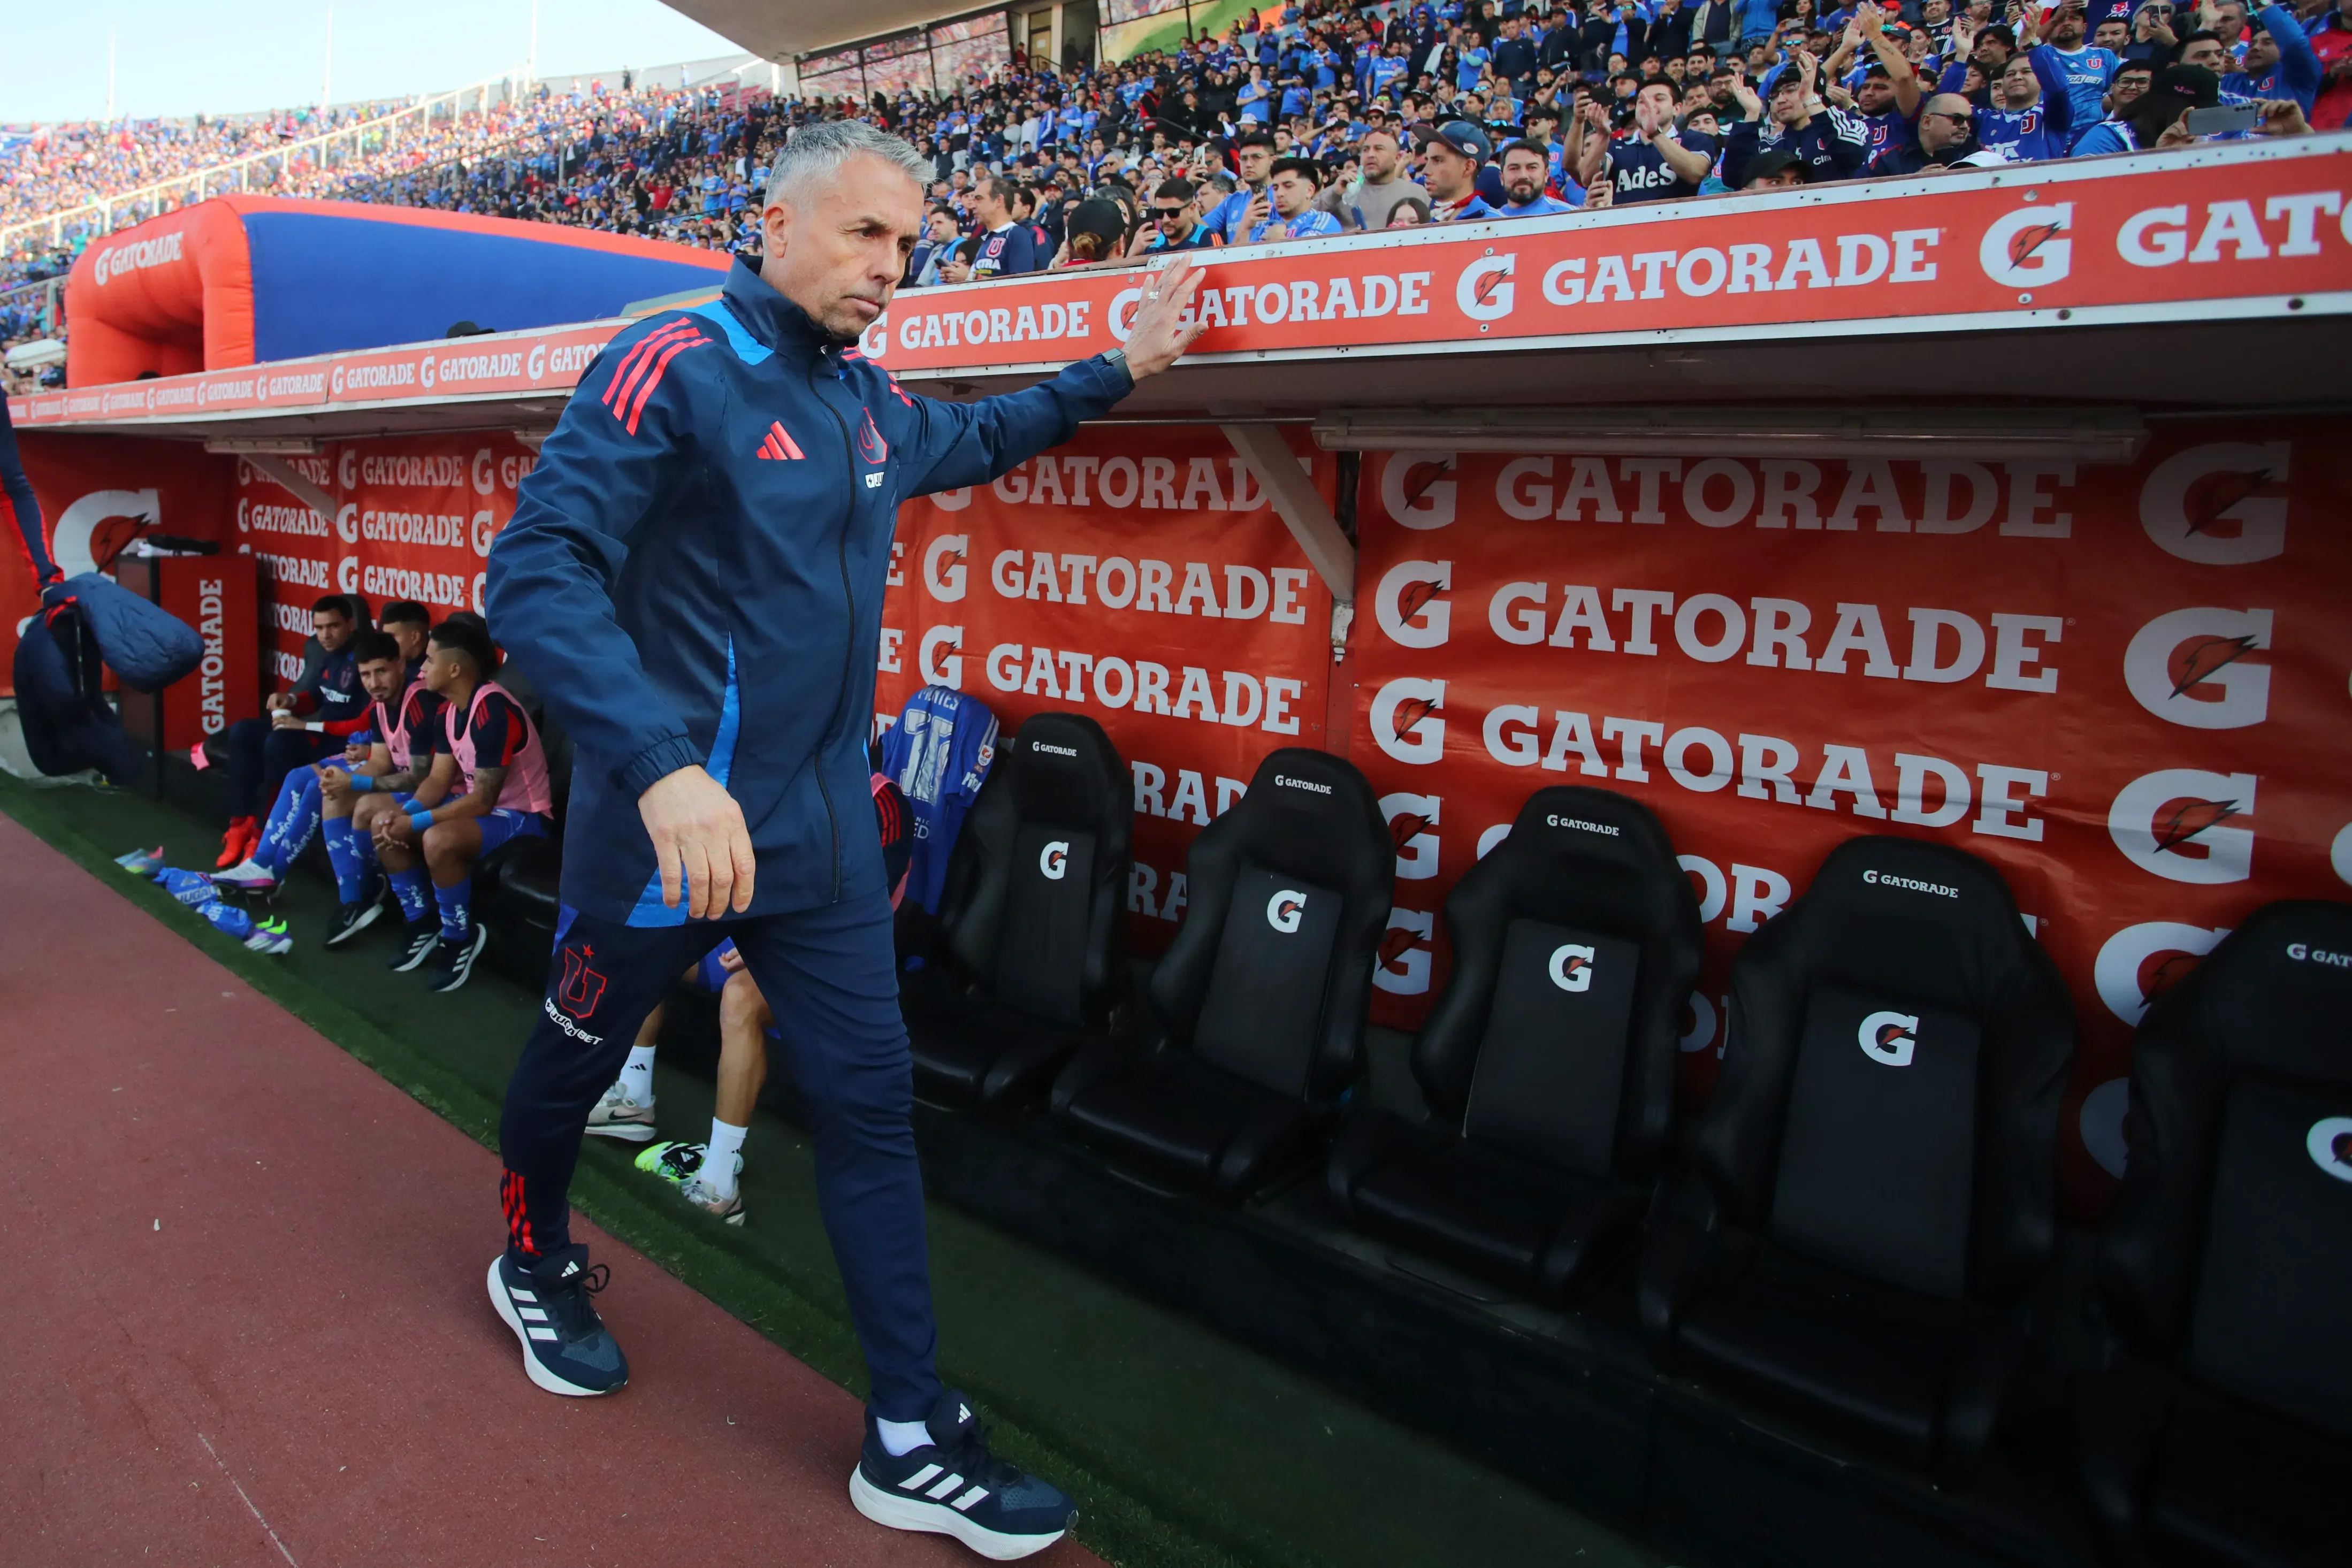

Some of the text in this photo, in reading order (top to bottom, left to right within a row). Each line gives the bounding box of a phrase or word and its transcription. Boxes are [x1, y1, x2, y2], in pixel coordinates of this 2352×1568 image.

[2086, 58, 2102, 70] U
[1616, 162, 1677, 193] AdeS
[94, 232, 184, 286] G GATORADE
[900, 301, 1090, 349] GATORADE
[1456, 253, 1516, 321] G
[1542, 228, 1939, 307] GATORADE
[1979, 202, 2072, 288] G
[2116, 191, 2352, 267] GAT
[986, 237, 1006, 258] U
[157, 387, 195, 406] GATORADE
[197, 382, 207, 406] G
[208, 380, 254, 400] GATORADE
[257, 376, 267, 401] G
[270, 373, 324, 395] GATORADE
[332, 343, 609, 394] G GATORADE G GATORADE G GATO
[338, 449, 356, 490] G
[362, 456, 463, 486] GATORADE
[472, 448, 493, 495] G
[994, 456, 1312, 512] GATORAD
[1381, 440, 2290, 565] G GATORADE G
[238, 498, 493, 557] G GATORADE G GATORADE G
[256, 553, 329, 588] TORADE
[337, 556, 358, 594] G
[364, 565, 464, 607] GATORADE
[923, 534, 968, 602] G
[991, 548, 1308, 625] GATORADE
[200, 579, 224, 735] GATORADE
[1375, 560, 2274, 730] G GATORADE G
[919, 624, 965, 690] G
[986, 643, 1302, 736] GATORADE
[1033, 741, 1077, 757] G GATORADE
[1275, 775, 1331, 794] G GATORADE
[1370, 677, 1446, 765] G
[1483, 704, 2048, 842] GATORADE
[2108, 768, 2257, 884] G
[1547, 814, 1619, 836] G GATORADE
[1040, 841, 1069, 880] G
[1863, 870, 1959, 899] G GATORADE
[1266, 890, 1307, 934] G
[1549, 944, 1595, 992] G
[2287, 943, 2307, 960] G
[559, 946, 607, 1019] U
[549, 1007, 603, 1045] JUGABET
[1858, 1011, 1919, 1066] G
